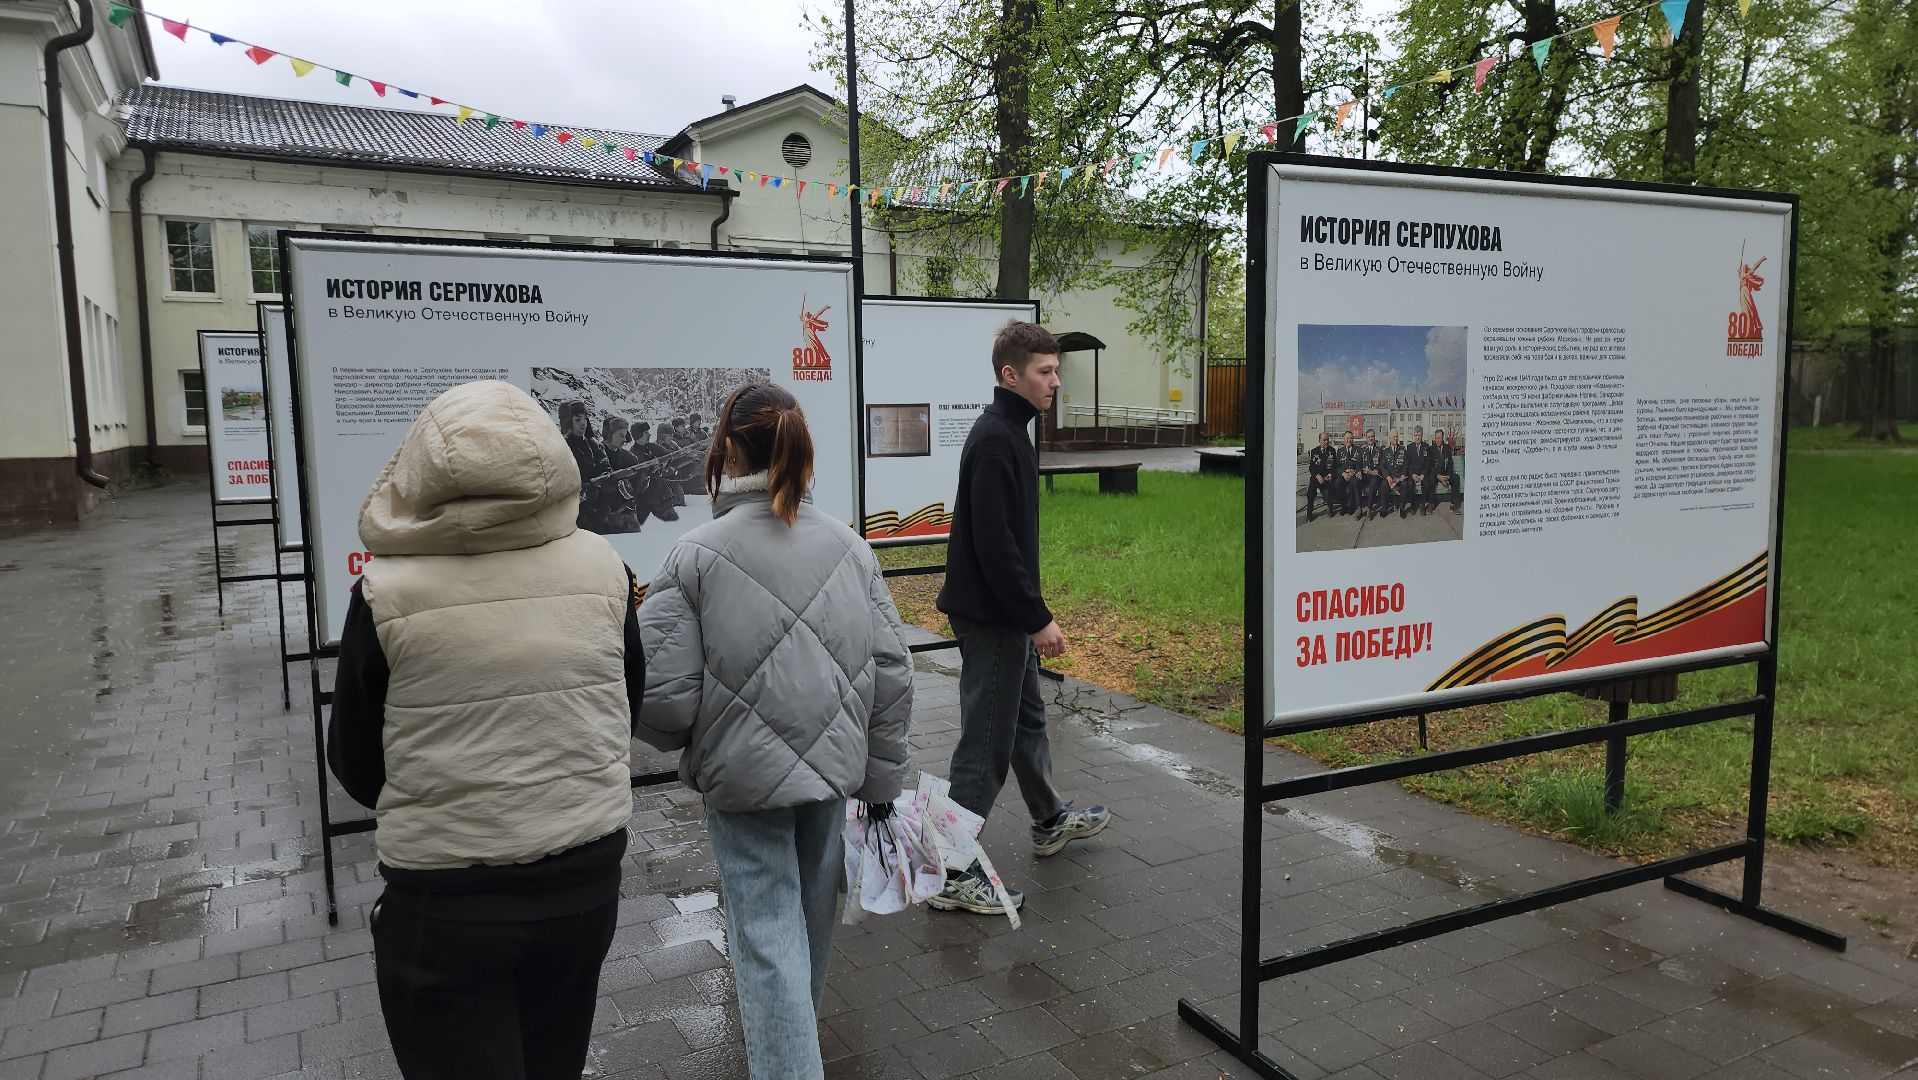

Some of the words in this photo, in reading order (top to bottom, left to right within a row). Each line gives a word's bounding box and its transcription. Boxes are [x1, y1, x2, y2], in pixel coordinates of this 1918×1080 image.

[1300, 215, 1391, 247] ИСТОРИЯ
[1396, 221, 1503, 252] СЕРПУХОВА
[1300, 256, 1309, 270] в
[1314, 253, 1383, 276] Великую
[1387, 256, 1499, 281] Отечественную
[1503, 260, 1544, 282] Войну
[326, 278, 422, 300] ИСТОРИЯ
[429, 281, 544, 304] СЕРПУХОВА
[328, 308, 338, 318] в
[343, 305, 416, 323] Великую
[421, 307, 541, 325] Отечественную
[545, 309, 589, 326] Войну
[1727, 311, 1749, 339] 80
[218, 347, 260, 356] ИСТОРИЯ
[792, 347, 814, 367] 80
[1727, 342, 1763, 359] ПОБЕДА!
[793, 370, 832, 382] ПОБЕДА!
[228, 474, 244, 485] ЗА
[1296, 582, 1405, 623] СПАСИБО
[1296, 634, 1328, 668] ЗА
[1335, 621, 1433, 663] ПОБЕДУ!
